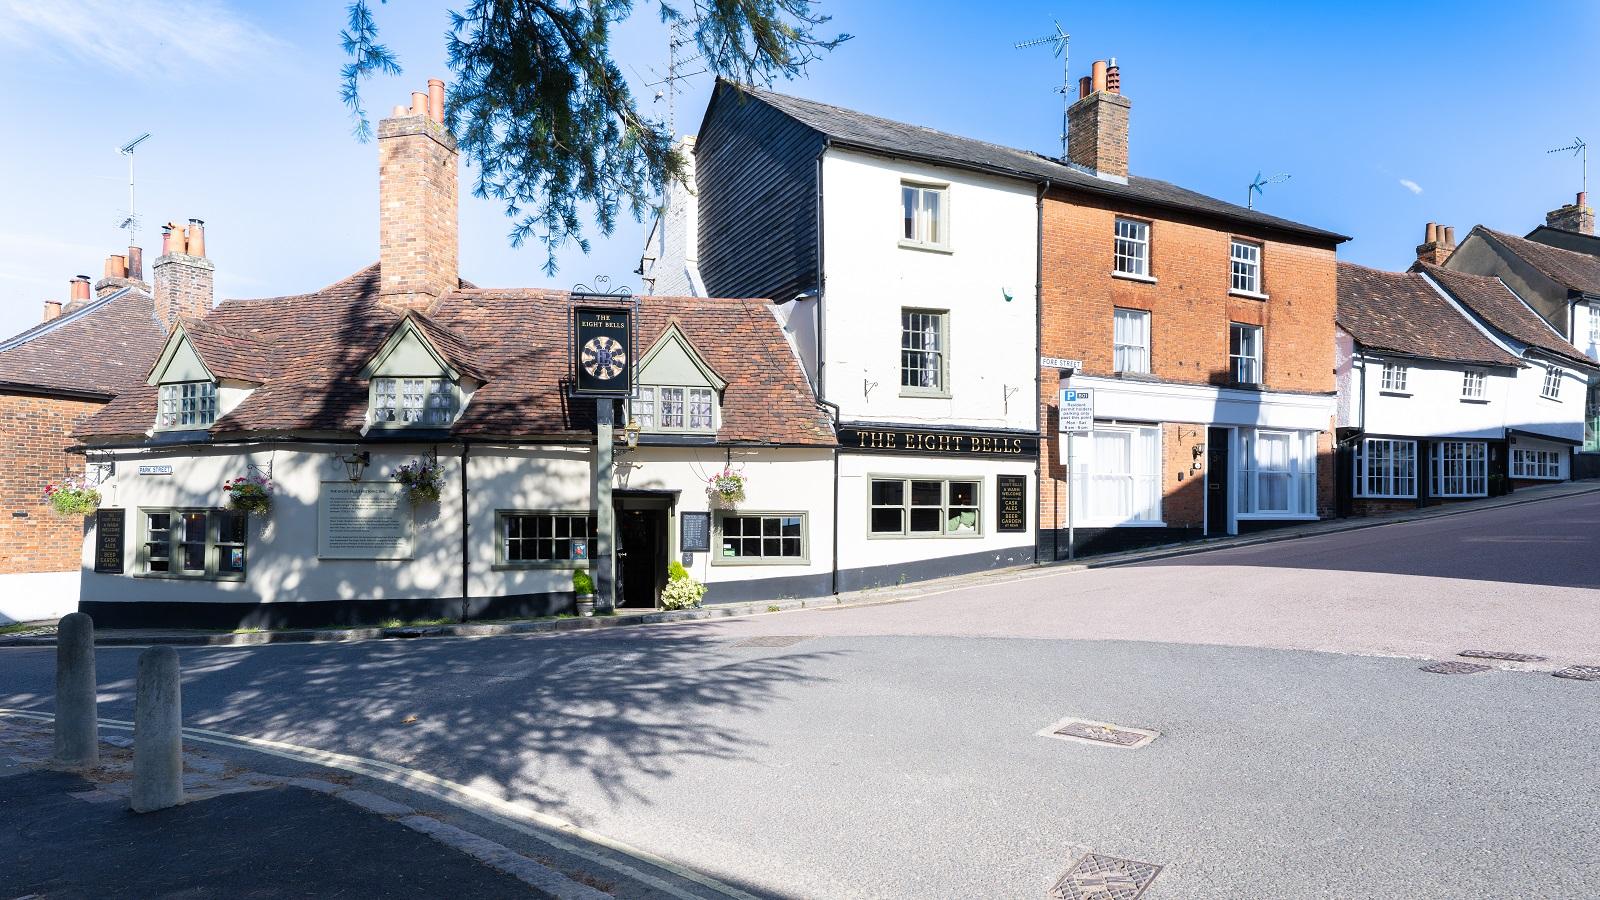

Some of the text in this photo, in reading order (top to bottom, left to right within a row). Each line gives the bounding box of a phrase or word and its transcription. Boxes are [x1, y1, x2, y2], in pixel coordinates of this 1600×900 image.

[1060, 360, 1080, 368] STREET
[857, 432, 1022, 453] THE EIGHT BELLS
